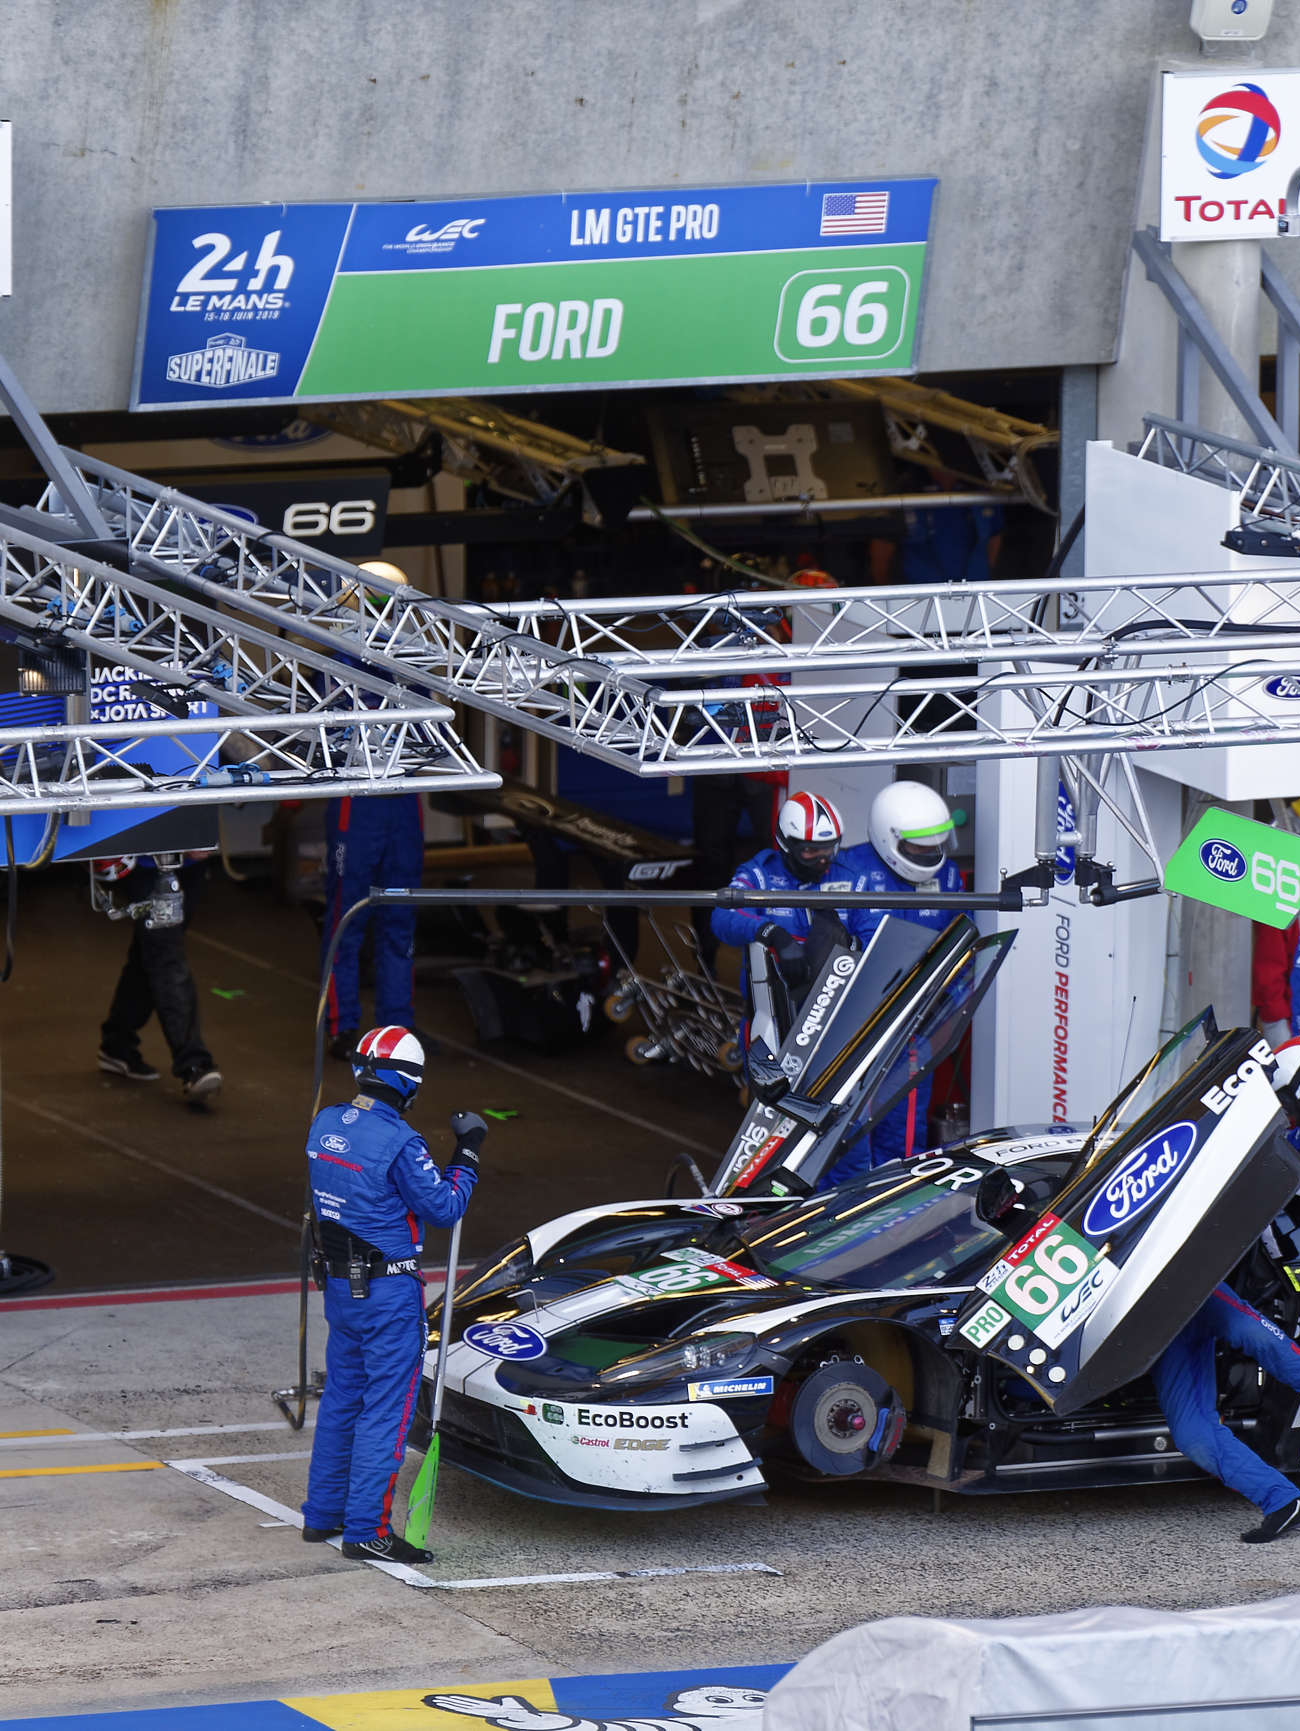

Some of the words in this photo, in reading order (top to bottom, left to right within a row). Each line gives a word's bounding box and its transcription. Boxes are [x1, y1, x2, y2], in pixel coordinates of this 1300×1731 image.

[405, 218, 487, 242] WEC
[570, 208, 611, 246] LM
[616, 206, 664, 243] GTE
[669, 203, 720, 241] PRO
[176, 230, 295, 293] 24h
[169, 295, 204, 312] LE
[207, 293, 284, 311] MANS
[796, 281, 889, 348] 66
[487, 298, 624, 363] FORD
[168, 347, 277, 386] SUPERFINALE
[282, 499, 377, 537] 66
[1207, 843, 1240, 877] Ford
[1055, 913, 1070, 968] FORD
[796, 974, 846, 1047] brembo
[1105, 1139, 1179, 1220] Ford
[1007, 1218, 1055, 1261] TOTAL
[1004, 1234, 1089, 1316] 66
[1060, 1269, 1104, 1324] WEC
[480, 1323, 534, 1355] Ford
[965, 1305, 1005, 1344] PRO
[713, 1381, 767, 1394] MICHELIN
[577, 1408, 689, 1429] EcoBoost
[579, 1435, 610, 1449] Castrol
[613, 1437, 672, 1452] EDGE
